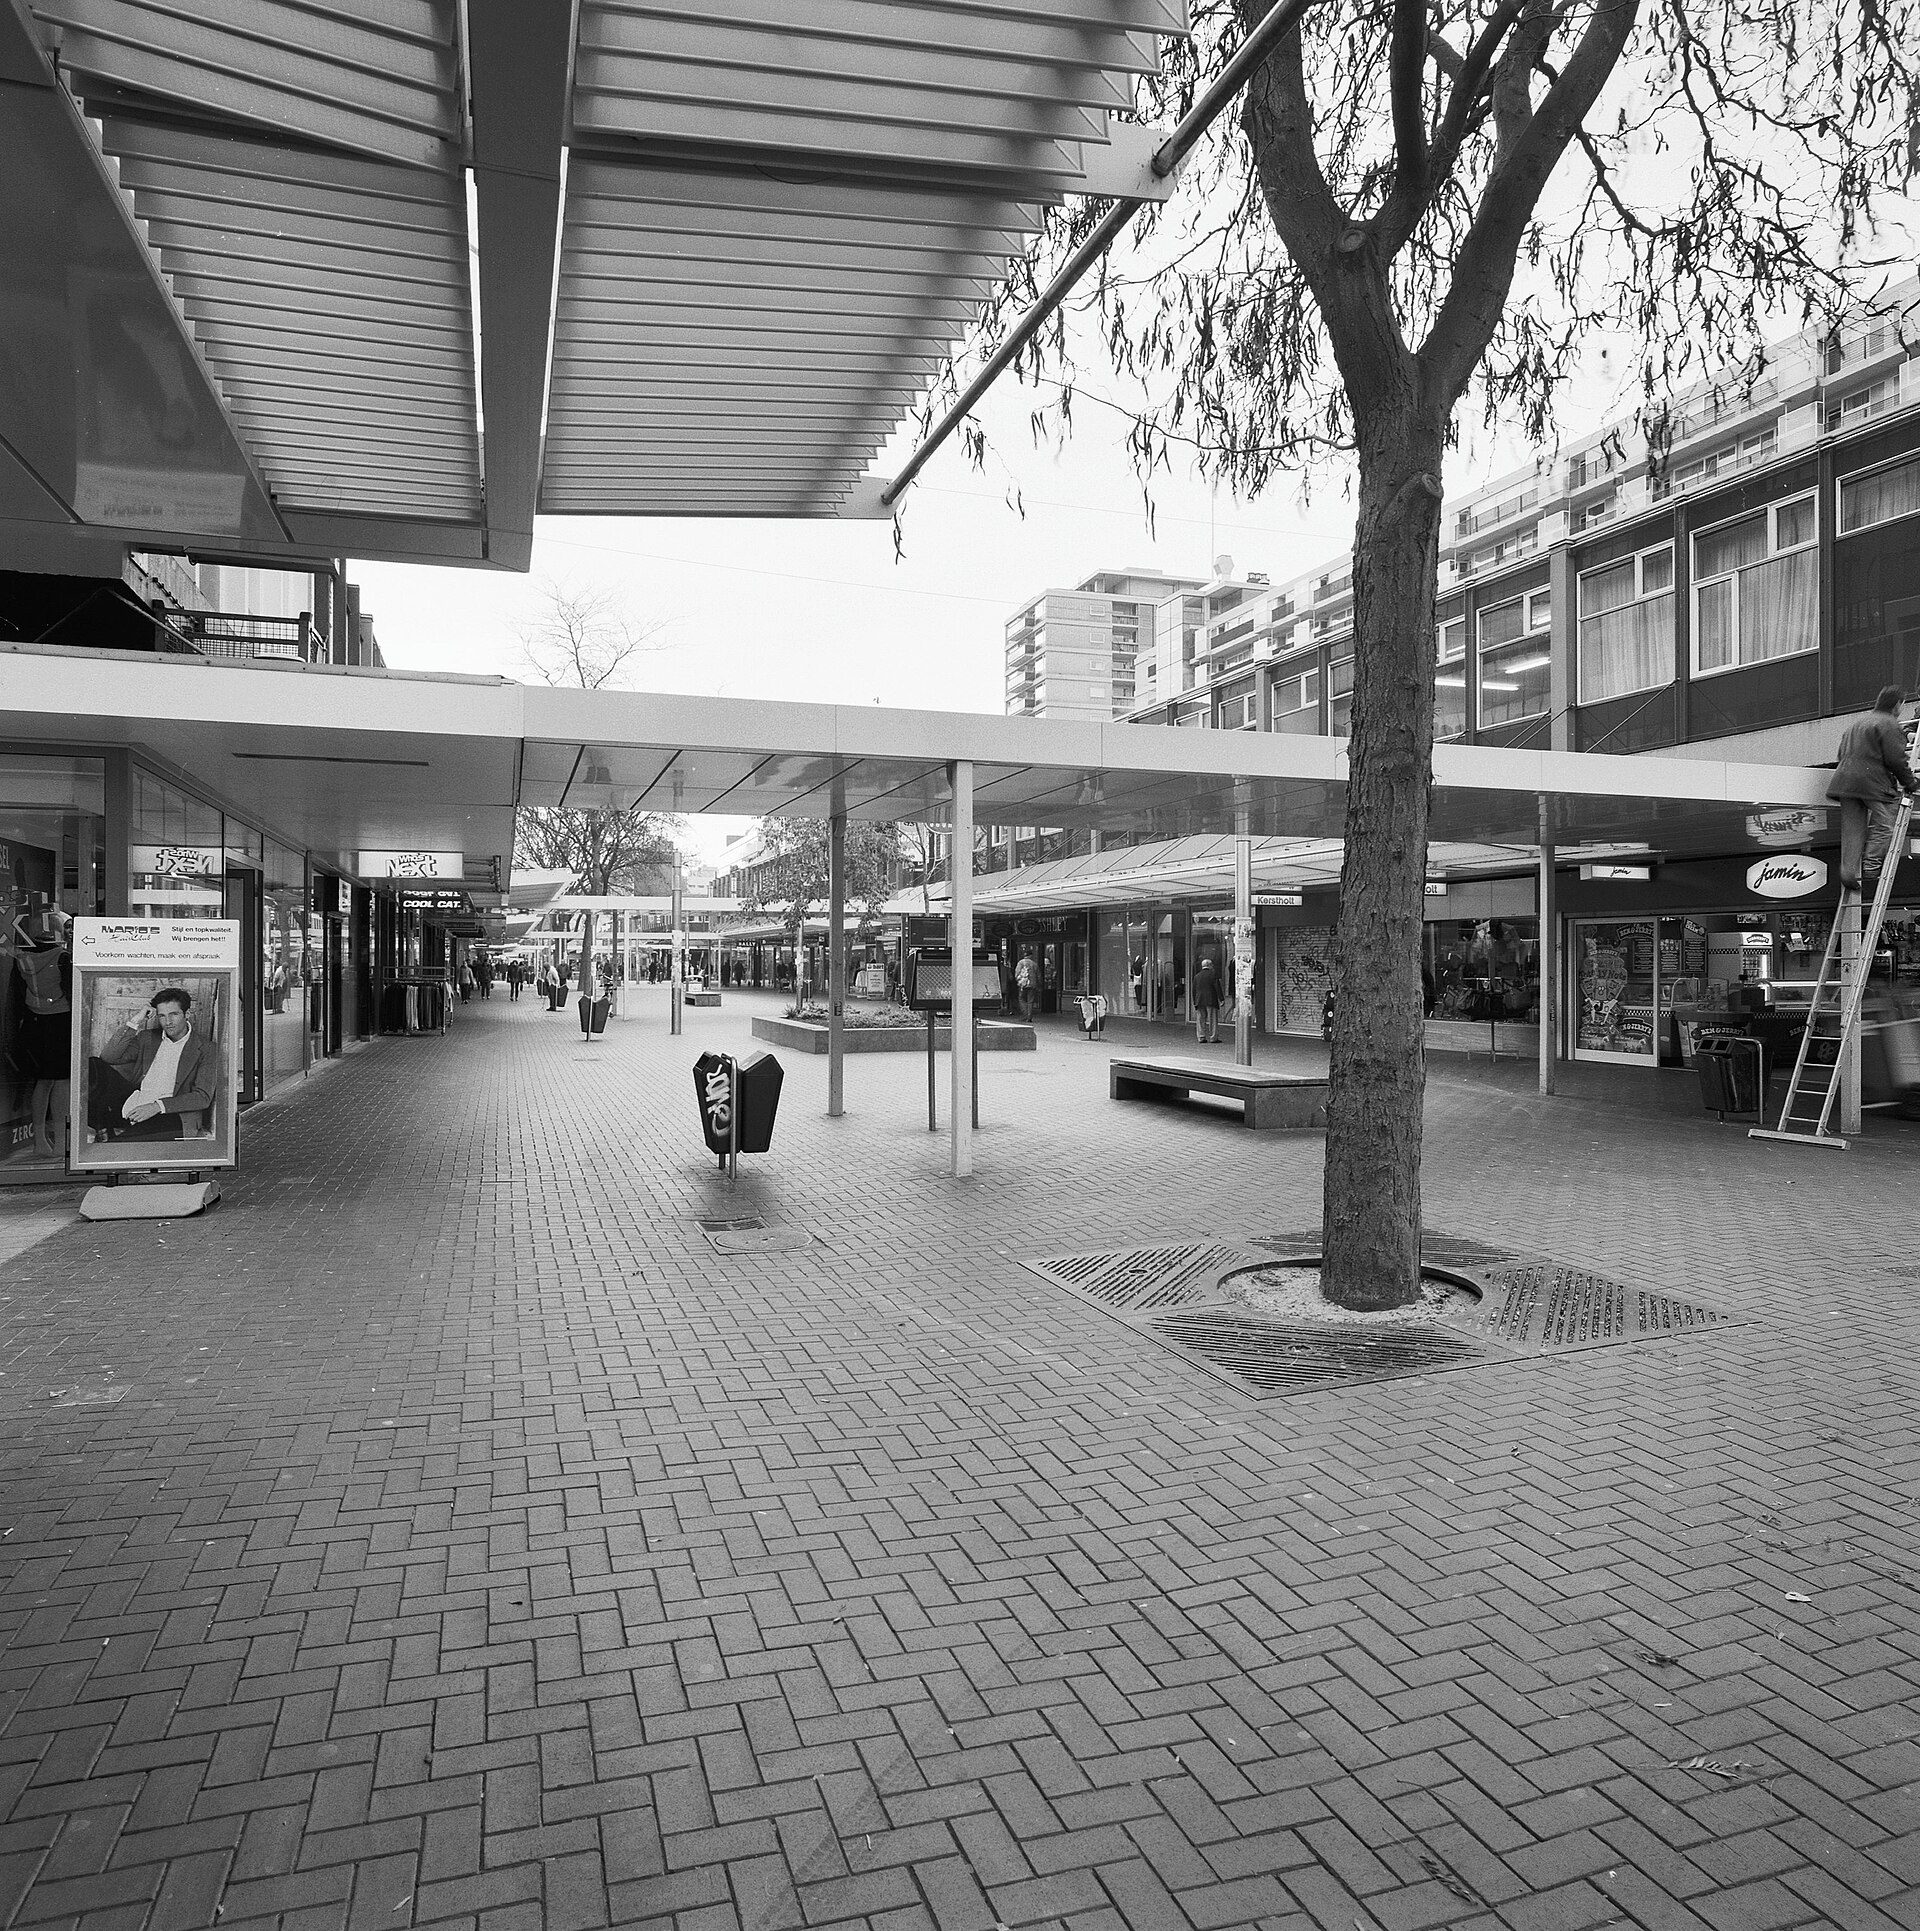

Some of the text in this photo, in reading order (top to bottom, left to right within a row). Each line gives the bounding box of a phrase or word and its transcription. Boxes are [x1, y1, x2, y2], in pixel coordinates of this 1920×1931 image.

[1754, 862, 1817, 889] jamin
[403, 900, 434, 908] COOL
[1257, 896, 1295, 905] Kerstholt
